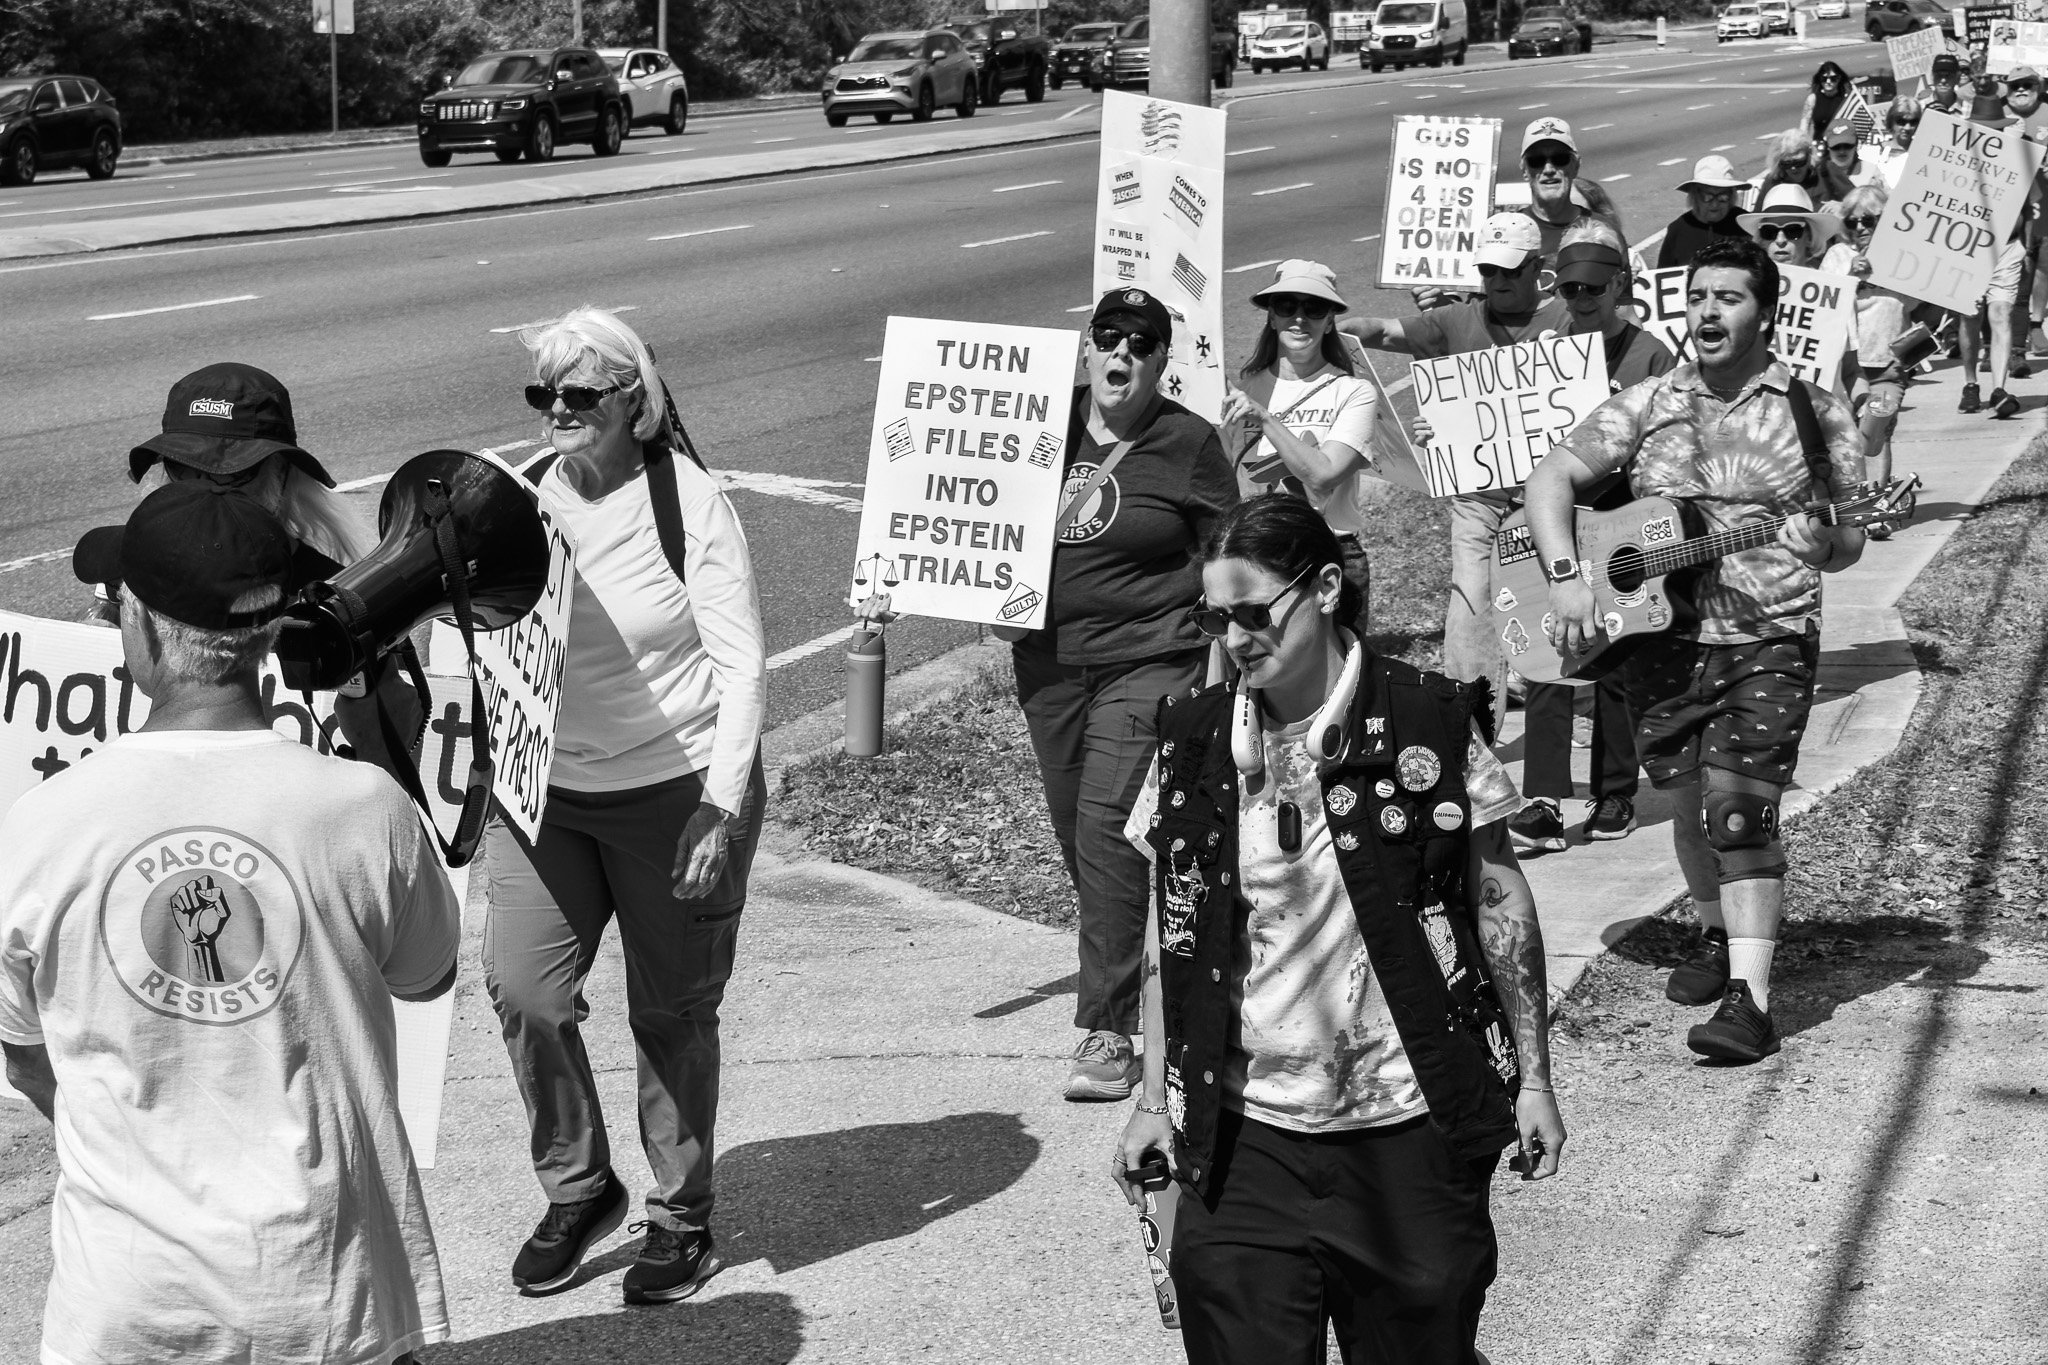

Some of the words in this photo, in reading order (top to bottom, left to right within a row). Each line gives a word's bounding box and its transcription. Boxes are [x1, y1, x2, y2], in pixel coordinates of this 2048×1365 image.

[1415, 127, 1470, 147] GUS
[1115, 170, 1134, 182] WHEN
[1400, 157, 1424, 178] IS
[1435, 158, 1486, 180] NOT
[1927, 144, 2019, 186] DESERVE
[1175, 175, 1197, 199] COMES
[1197, 195, 1207, 208] TO
[1410, 185, 1426, 205] 4
[1439, 187, 1474, 207] US
[1915, 164, 1929, 178] A
[1941, 169, 2007, 202] VOICE
[1169, 189, 1203, 226] AMERICA
[1398, 206, 1473, 229] OPEN
[1922, 190, 1994, 222] PLEASE
[1109, 228, 1116, 236] IT
[1118, 229, 1133, 240] WILL
[1135, 232, 1144, 241] BE
[1399, 228, 1475, 252] TOWN
[1893, 201, 1996, 258] STOP
[1102, 244, 1132, 256] WRAPPED
[1135, 250, 1142, 259] IN
[1144, 251, 1150, 260] A
[1395, 256, 1465, 279] HALL
[1800, 281, 1841, 310] ON
[1775, 302, 1814, 331] HE
[936, 339, 1030, 374] TURN
[1768, 331, 1820, 361] AVE
[1413, 333, 1593, 406] DEMOCRACY
[192, 401, 231, 416] CSUSM
[904, 381, 1049, 423] EPSTEIN
[1475, 386, 1576, 442] DIES
[925, 427, 1020, 463] FILES
[1426, 444, 1459, 497] IN
[1474, 429, 1566, 491] SILE
[925, 473, 999, 507] INTO
[889, 511, 1025, 552] EPSTEIN
[1061, 517, 1103, 539] SISTS
[1499, 538, 1533, 558] BRAV
[1500, 556, 1513, 565] FOR
[1512, 551, 1530, 561] STATE
[898, 553, 1013, 591] TRIALS
[1004, 595, 1036, 616] GUILTY
[489, 609, 566, 734] EEDOM
[499, 700, 549, 824] PRESS
[134, 839, 260, 884] PASCO
[138, 966, 279, 1015] RESISTS
